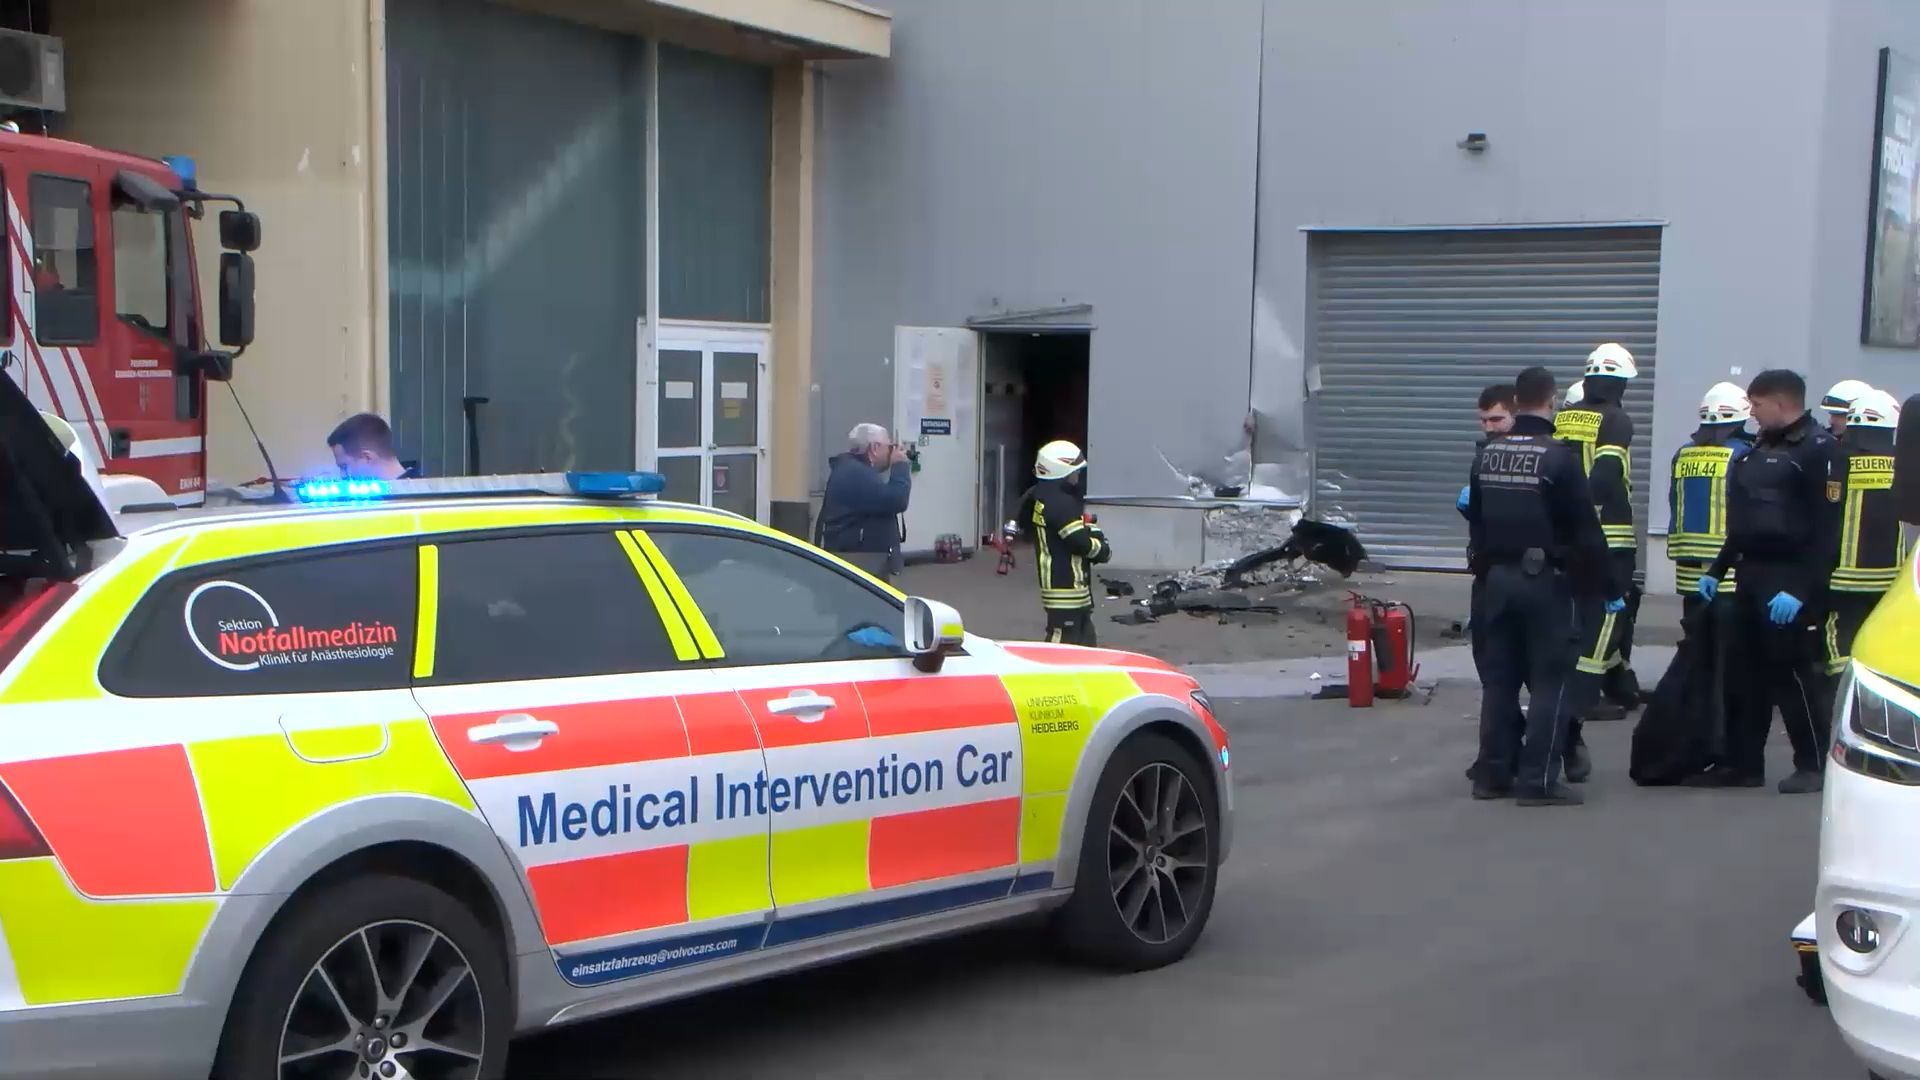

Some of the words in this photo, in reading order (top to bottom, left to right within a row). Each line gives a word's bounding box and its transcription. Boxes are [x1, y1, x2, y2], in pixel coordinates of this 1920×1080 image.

[1557, 411, 1602, 426] FEUERWEHR
[1480, 451, 1541, 474] POLIZEI
[1680, 461, 1700, 477] ENH
[1701, 462, 1717, 477] 44
[218, 619, 263, 633] Sektion
[218, 620, 398, 656] Notfallmedizin
[258, 653, 291, 667] Klinik
[291, 651, 309, 665] für
[310, 645, 395, 662] Anästhesiologie
[1031, 720, 1080, 734] HEIDELBERG
[518, 775, 698, 848] Medical
[716, 753, 944, 821] Intervention
[956, 743, 1014, 788] Car
[571, 937, 738, 978] einsatzfahrzeug@volvocars.com
